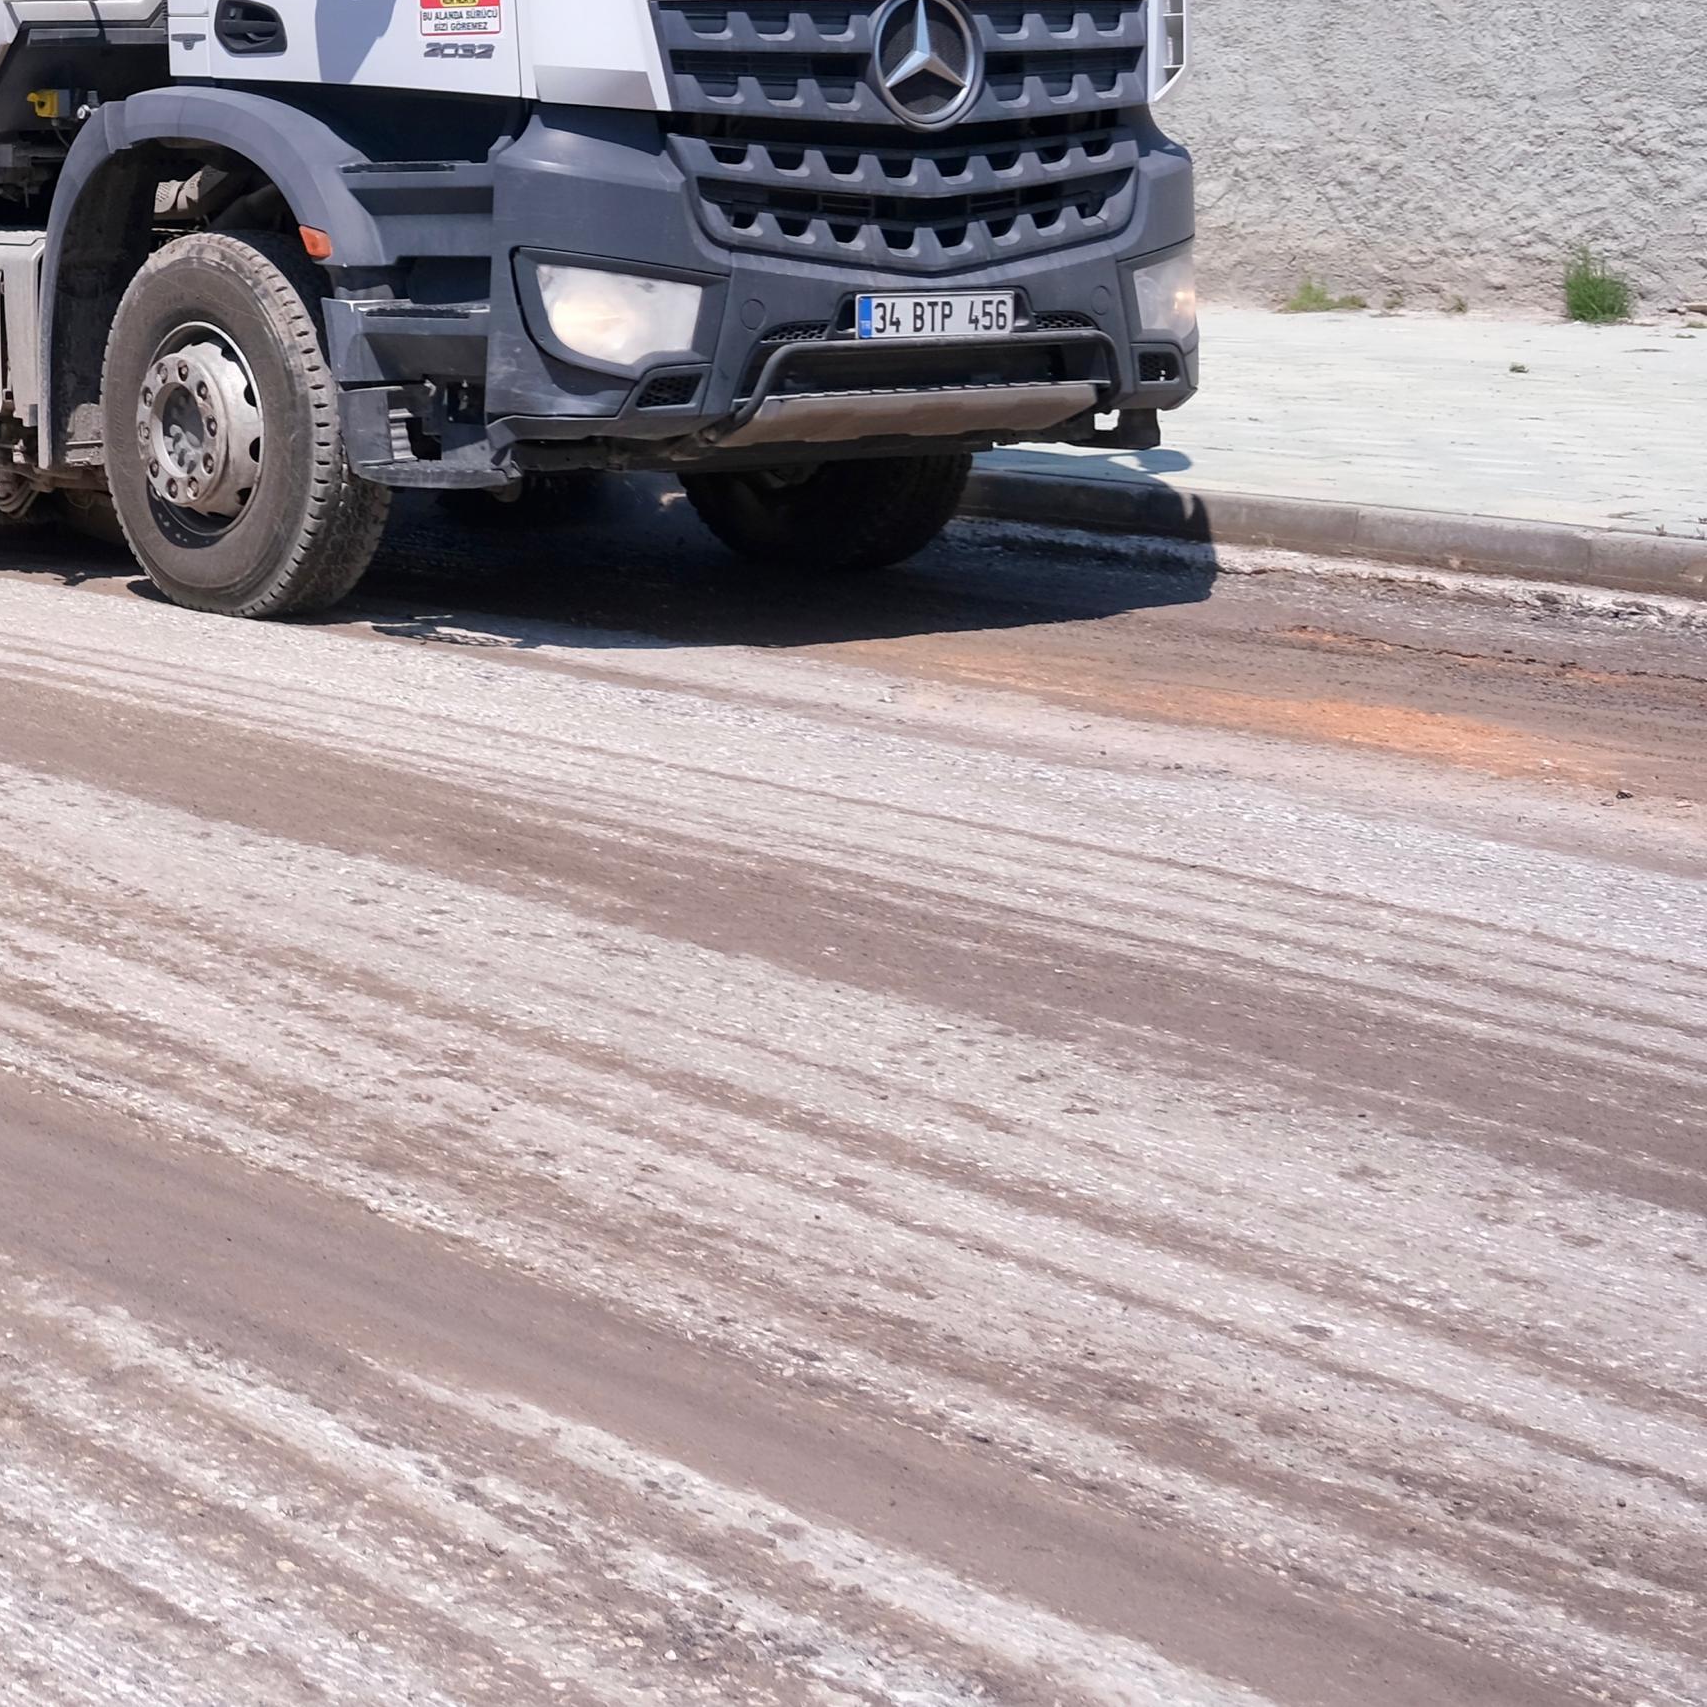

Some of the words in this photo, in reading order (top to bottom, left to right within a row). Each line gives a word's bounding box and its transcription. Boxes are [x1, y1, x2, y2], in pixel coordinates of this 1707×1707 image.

[874, 302, 901, 333] 34
[912, 300, 953, 333] BTP
[968, 299, 1007, 331] 456
